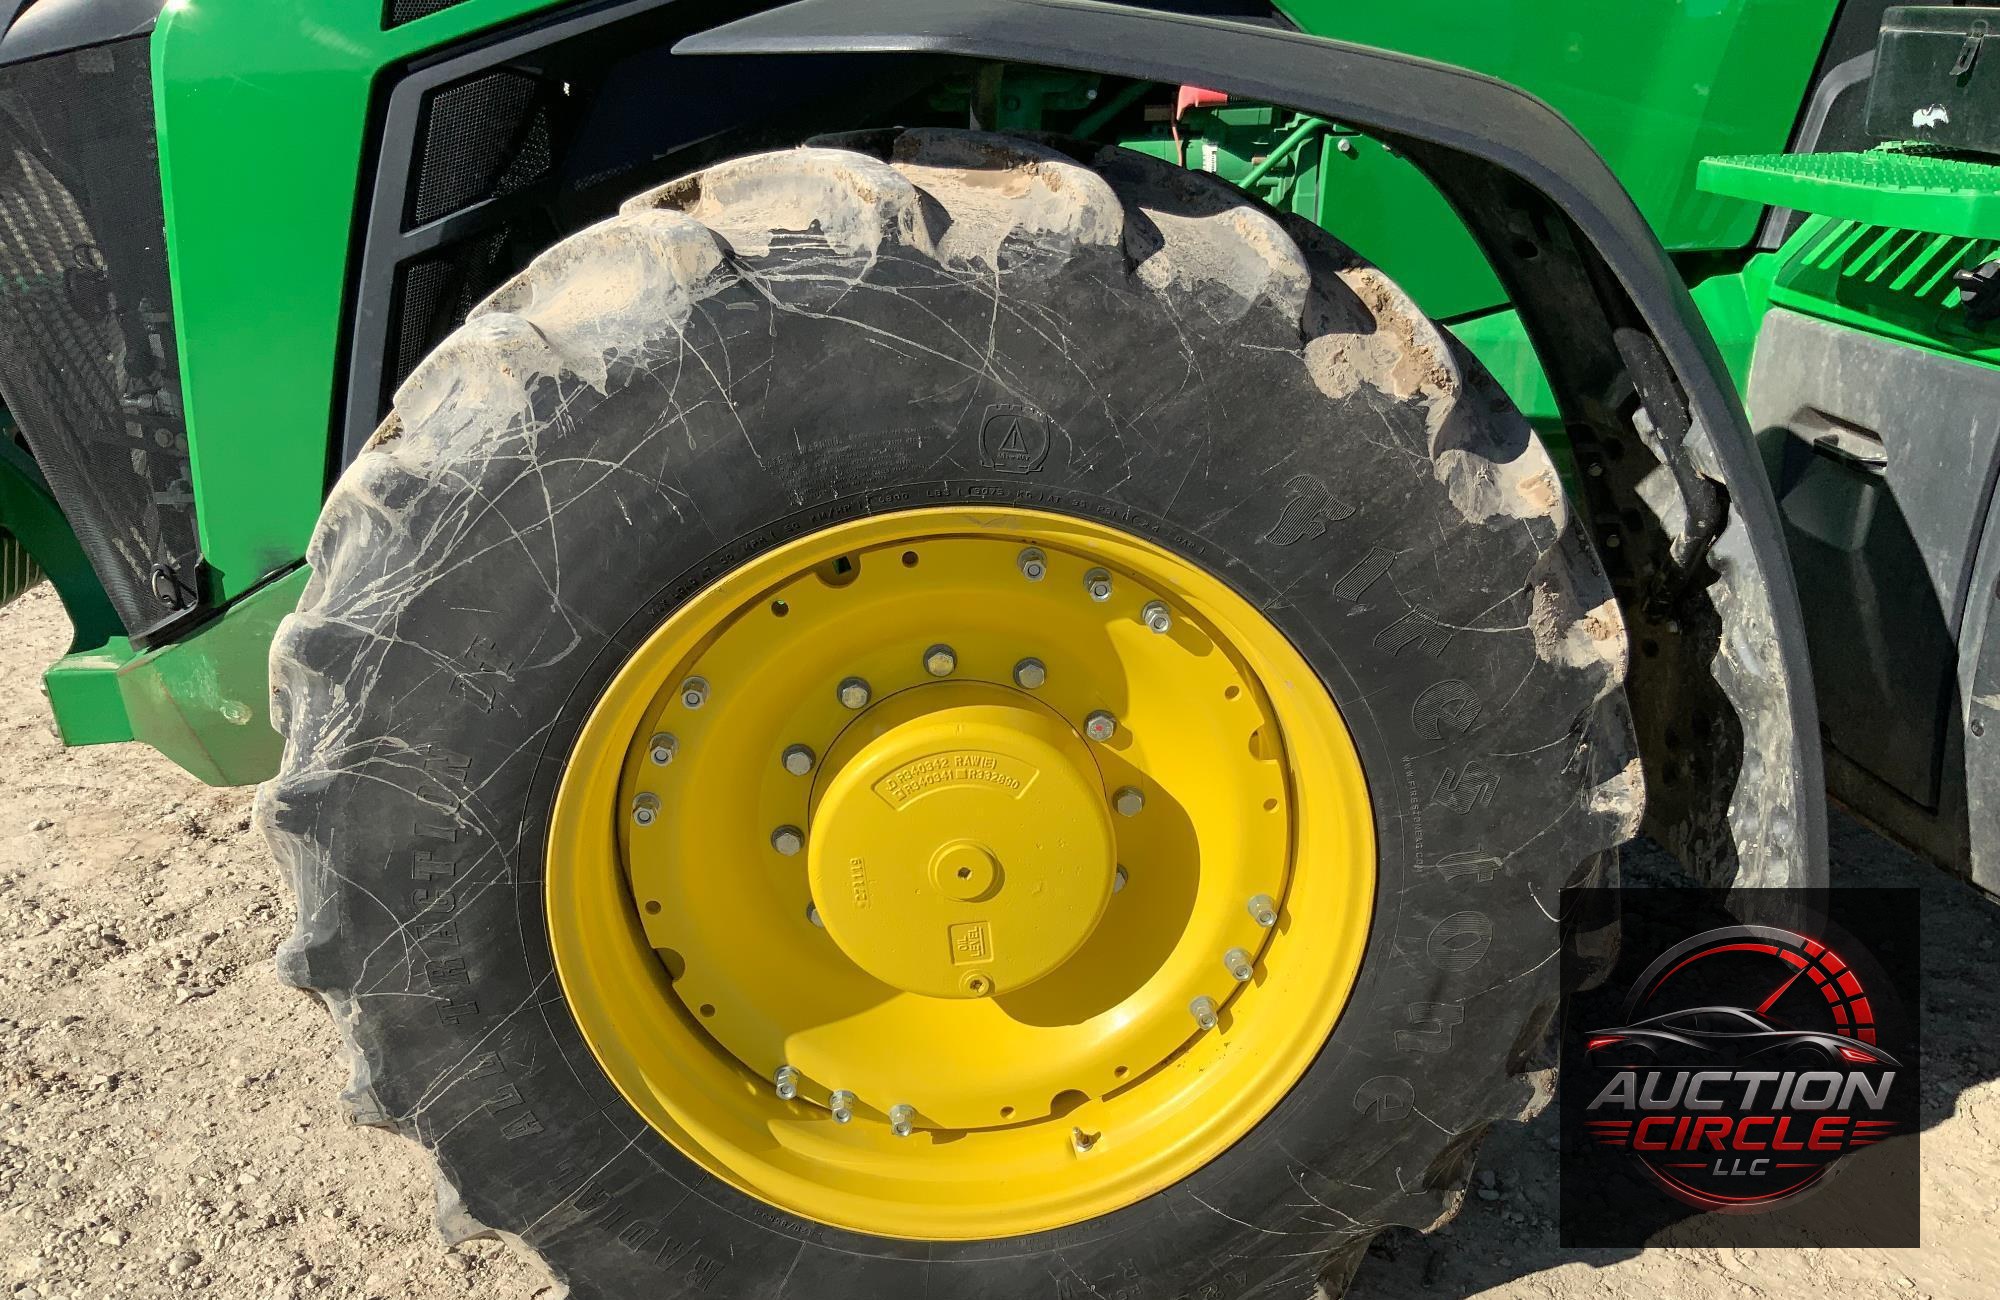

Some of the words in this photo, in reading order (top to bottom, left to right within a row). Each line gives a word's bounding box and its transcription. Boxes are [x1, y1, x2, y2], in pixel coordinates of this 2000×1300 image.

[449, 634, 514, 714] DT
[898, 759, 949, 784] R340342
[954, 755, 998, 770] RAW(E)
[905, 769, 954, 795] R340341
[1265, 473, 1502, 1122] Firestone
[411, 742, 480, 1026] TRACTION
[956, 934, 968, 951] OIL
[966, 926, 981, 957] LEVEL
[467, 1049, 544, 1142] ALL
[545, 1156, 727, 1293] RADIAL
